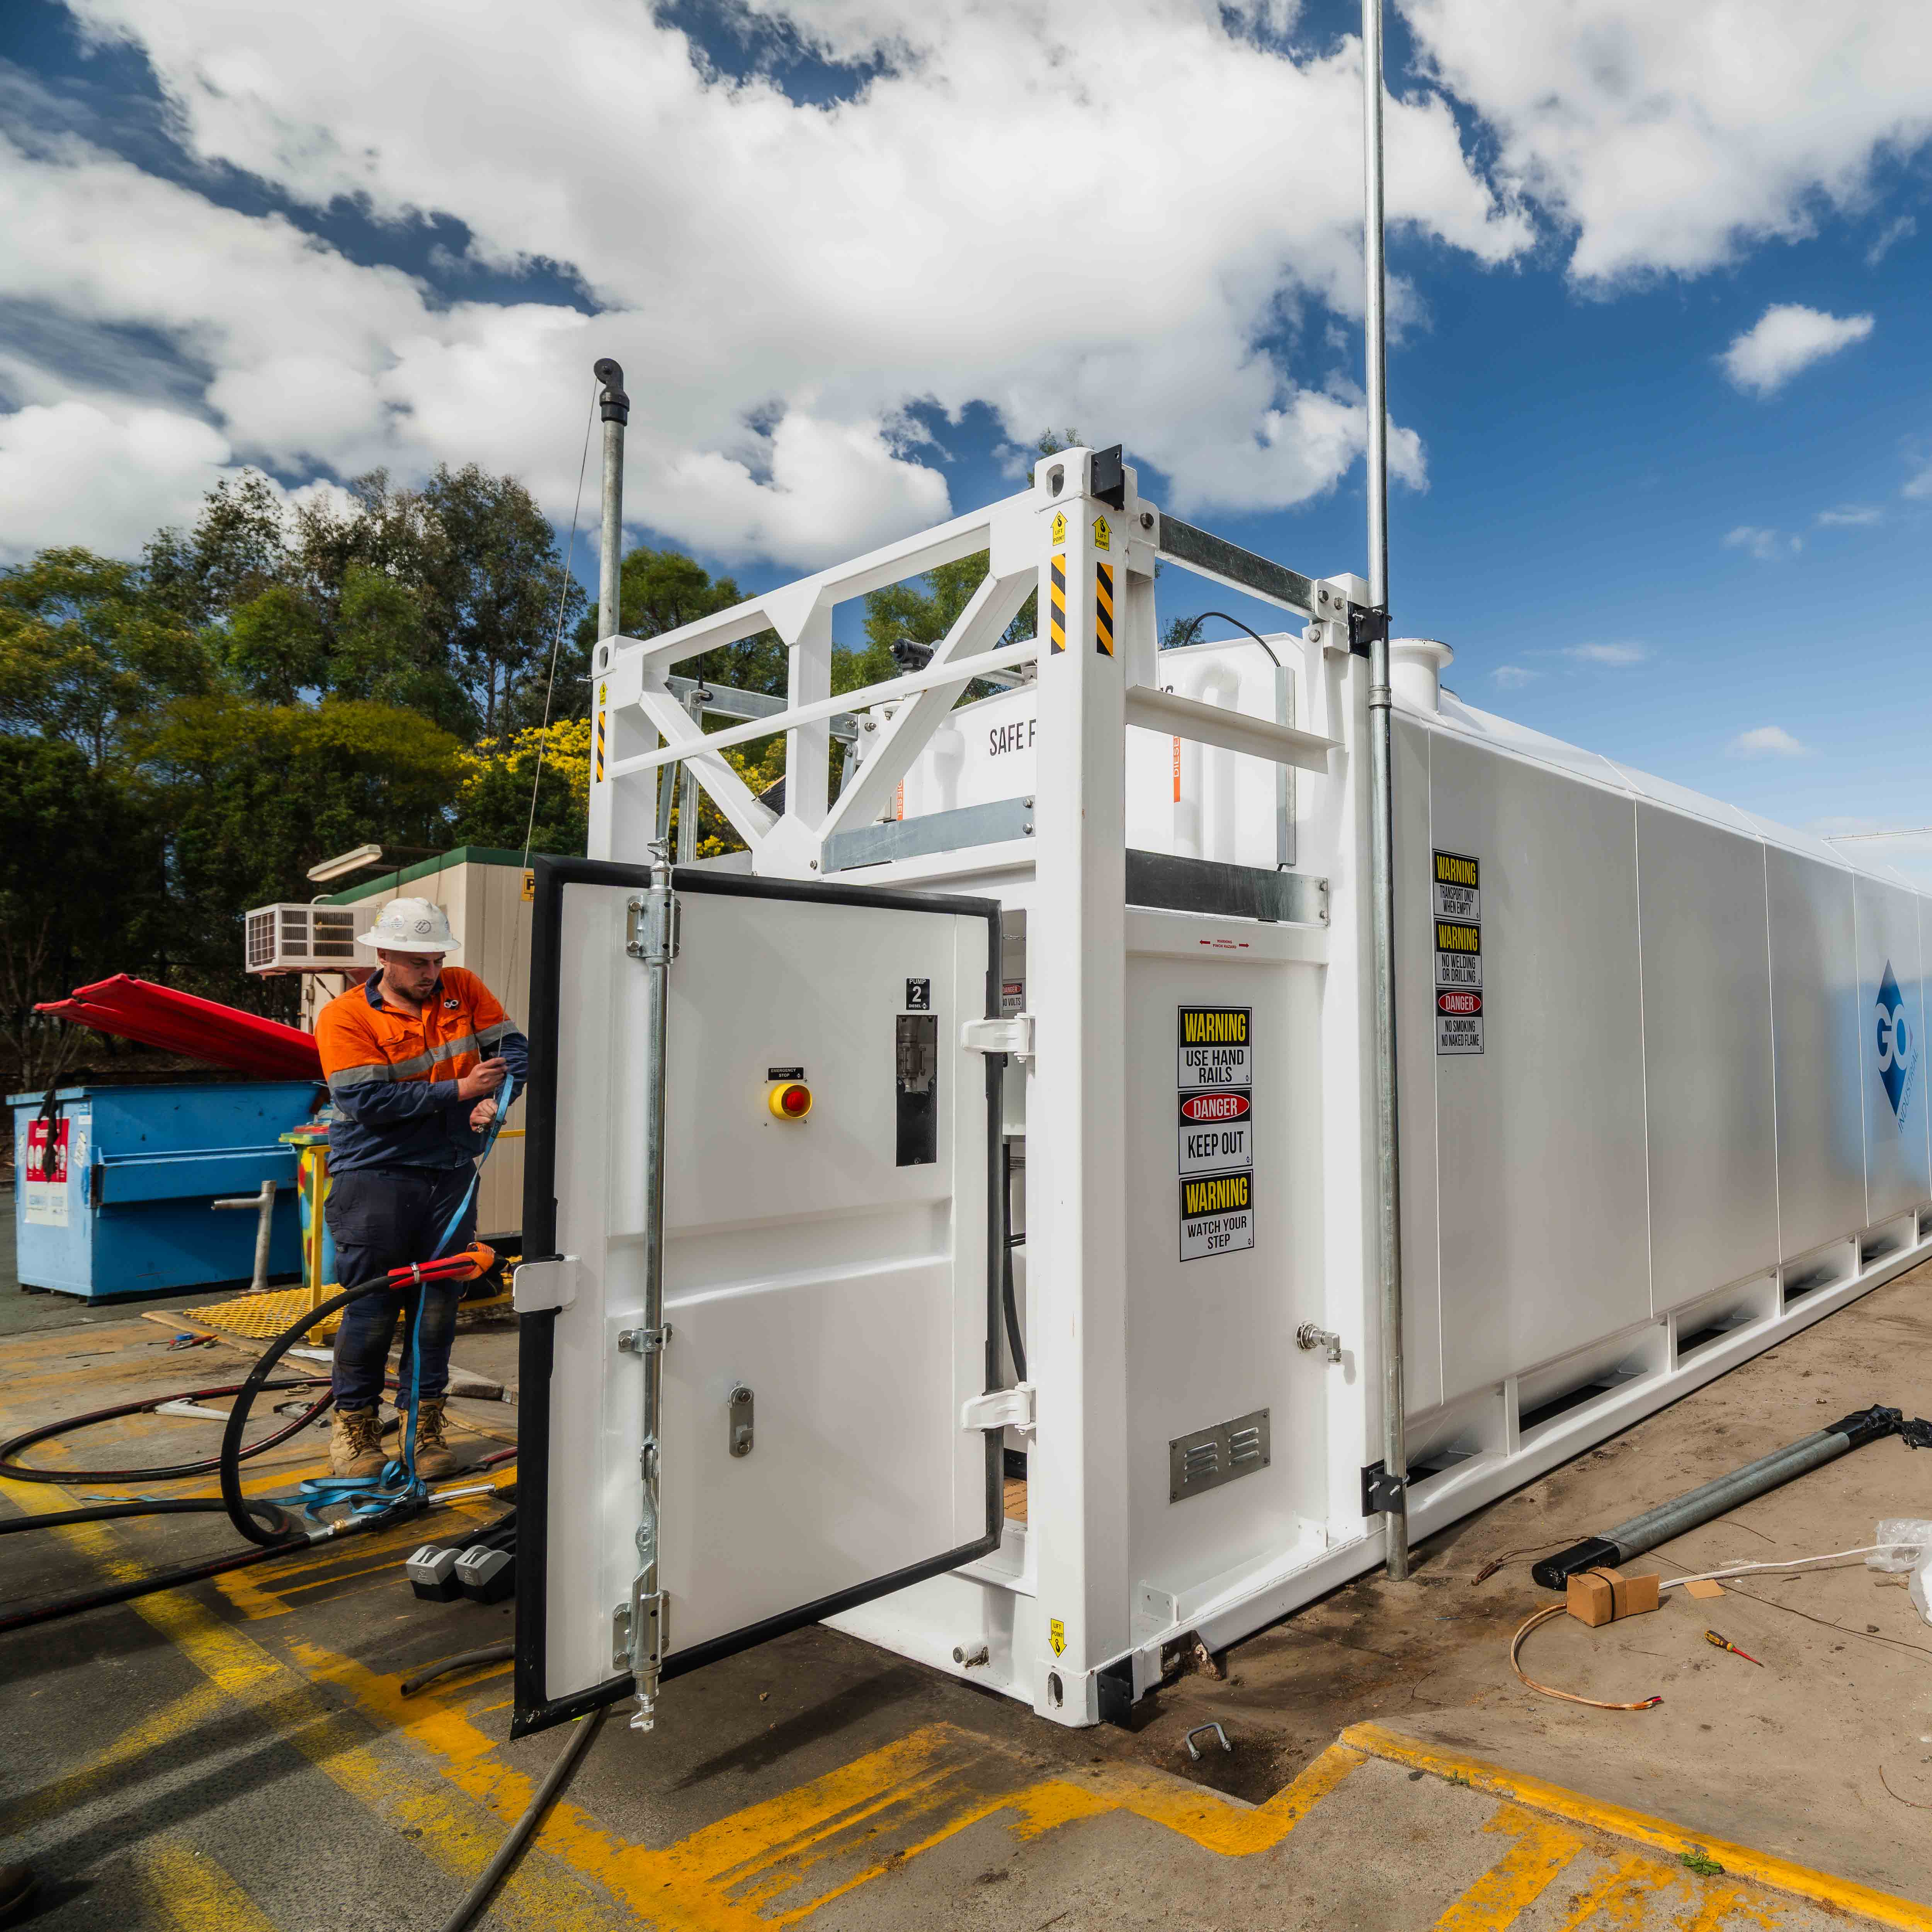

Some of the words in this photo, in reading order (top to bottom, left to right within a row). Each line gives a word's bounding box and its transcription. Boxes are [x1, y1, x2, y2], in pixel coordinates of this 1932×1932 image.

[1096, 539, 1108, 548] POINT
[990, 722, 1024, 756] SAFE
[1437, 855, 1476, 885] WARNING
[1440, 885, 1463, 901] TRANSPORT
[1464, 889, 1474, 903] ONLY
[1443, 899, 1456, 913] WHEN
[1457, 901, 1471, 915] EMPTY
[1439, 925, 1478, 951] WARNING
[1442, 954, 1449, 967] NO
[1451, 955, 1475, 969] WELDING
[1442, 968, 1450, 981] OR
[1451, 969, 1476, 983] DRILLING
[912, 986, 921, 1002] 2
[1008, 997, 1021, 1006] VOLTS
[1446, 995, 1474, 1010] DANGER
[444, 1000, 459, 1008] GO
[1185, 1014, 1245, 1041] WARNING
[1445, 1020, 1452, 1032] NO
[1453, 1020, 1475, 1032] SMOKING
[1442, 1034, 1448, 1046] NO
[1449, 1034, 1464, 1046] NAKED
[1465, 1034, 1480, 1046] FLAME
[1875, 1003, 1908, 1073] GO
[1186, 1050, 1208, 1066] USE
[1213, 1049, 1244, 1066] HAND
[1199, 1066, 1232, 1083] RAILS
[1898, 1048, 1919, 1134] INDUSTRIAL
[1194, 1098, 1237, 1118] DANGER
[1188, 1133, 1218, 1158] KEEP
[1222, 1131, 1244, 1155] OUT
[1186, 1177, 1247, 1213] WARNING
[1187, 1220, 1220, 1238] WATCH
[1223, 1216, 1247, 1231] YOUR
[1208, 1233, 1230, 1249] STEP
[1052, 1630, 1063, 1638] POINT
